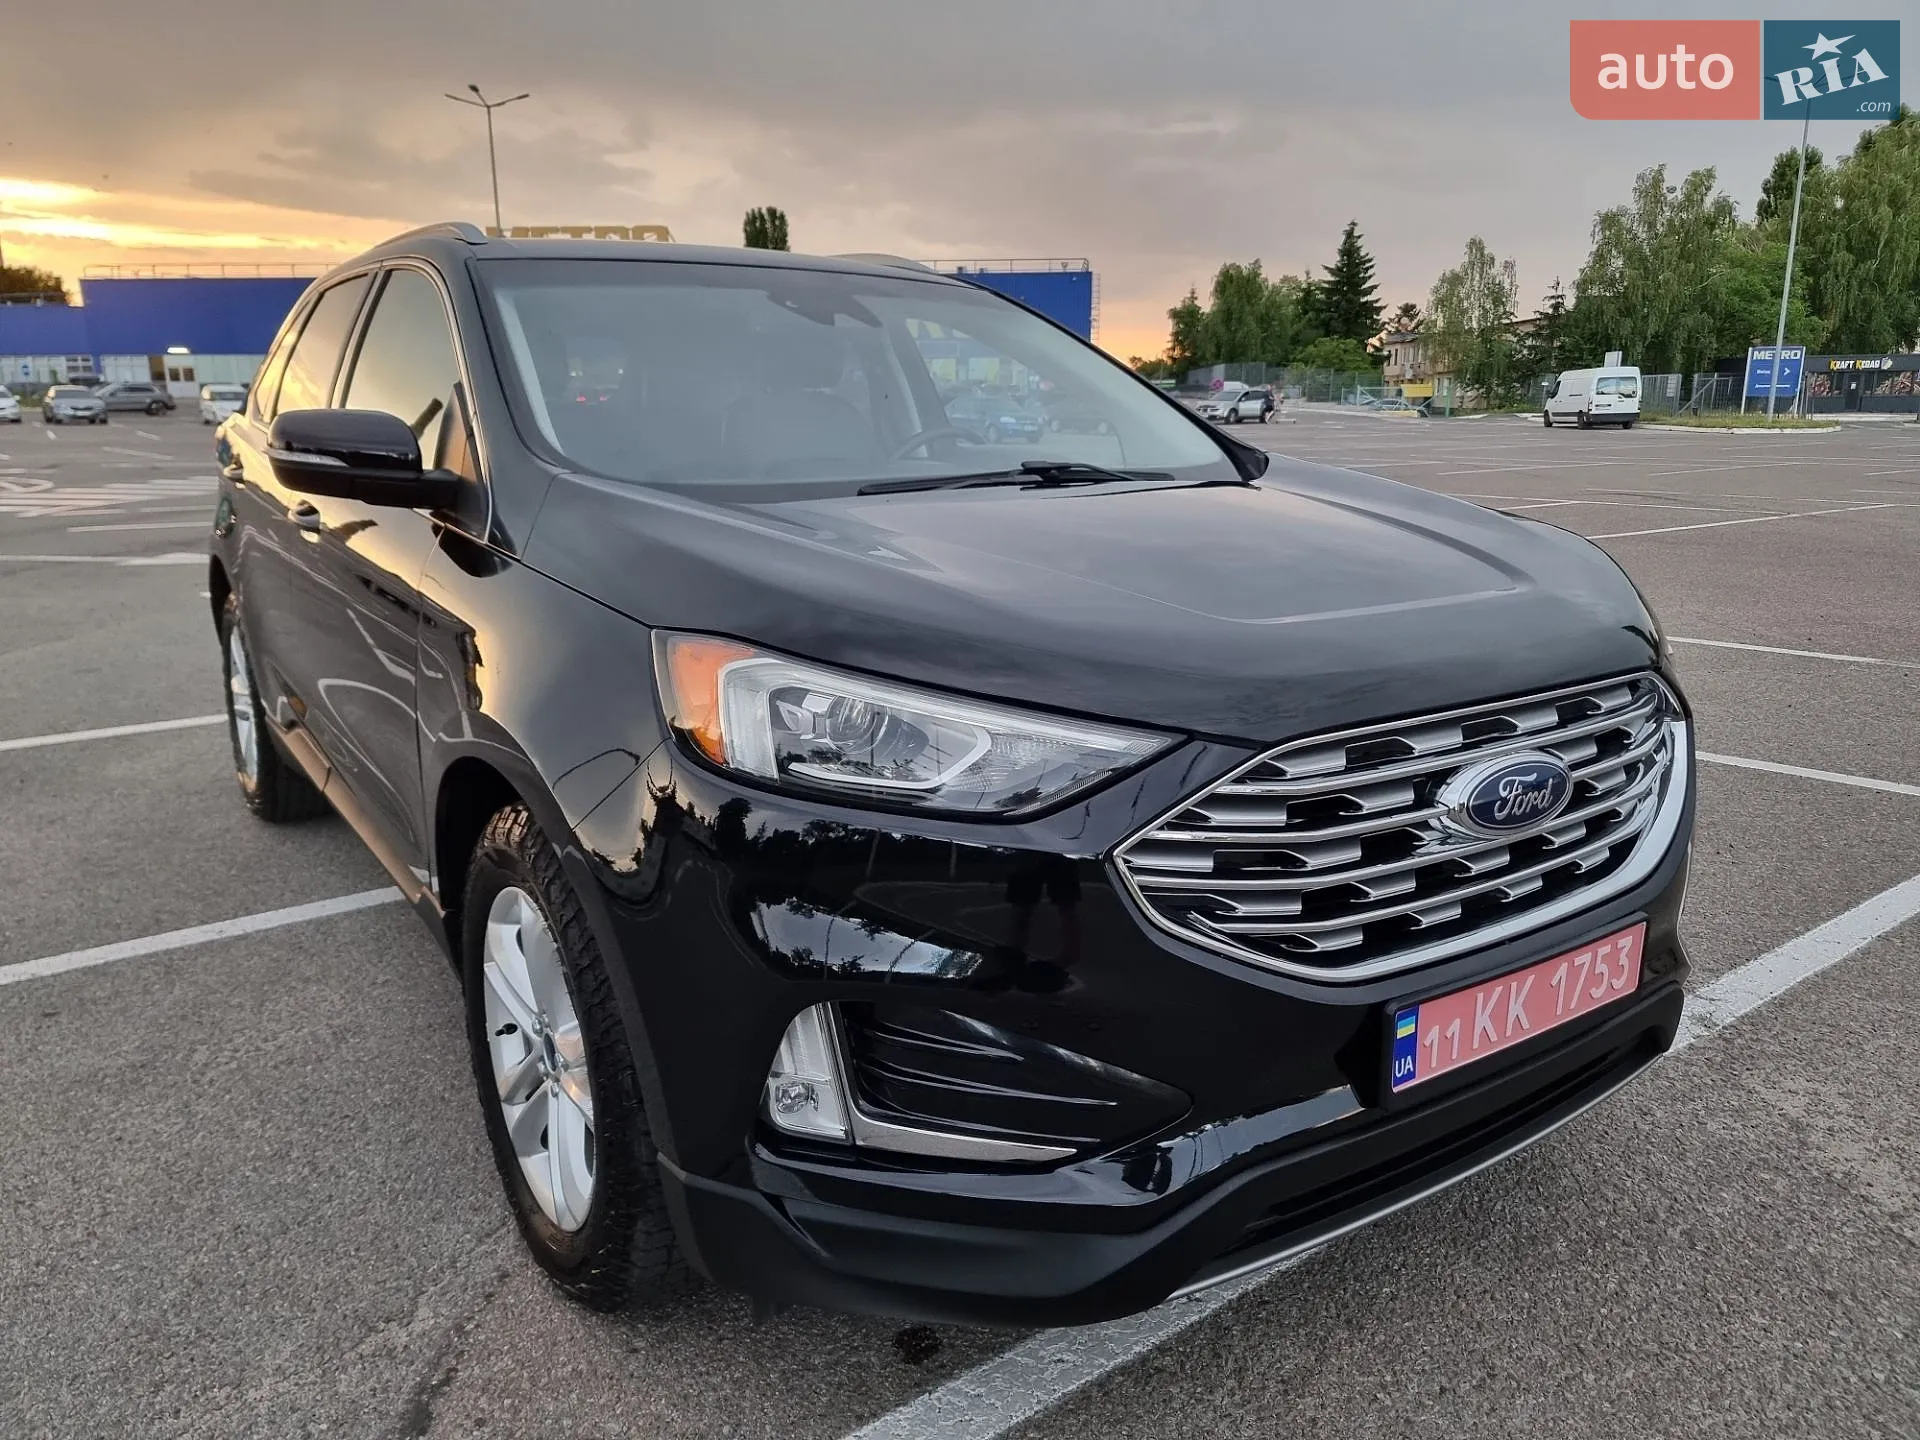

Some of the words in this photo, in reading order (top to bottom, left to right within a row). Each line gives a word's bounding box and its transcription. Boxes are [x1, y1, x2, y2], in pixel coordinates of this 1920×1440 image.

[1753, 350, 1801, 360] MERO
[1830, 360, 1855, 370] KRAFT
[1855, 360, 1880, 370] KEBAB
[1494, 772, 1553, 820] Ford
[1423, 1018, 1461, 1068] 11
[1472, 974, 1535, 1049] KK
[1550, 935, 1633, 1016] 1753
[1395, 1055, 1414, 1078] UA
